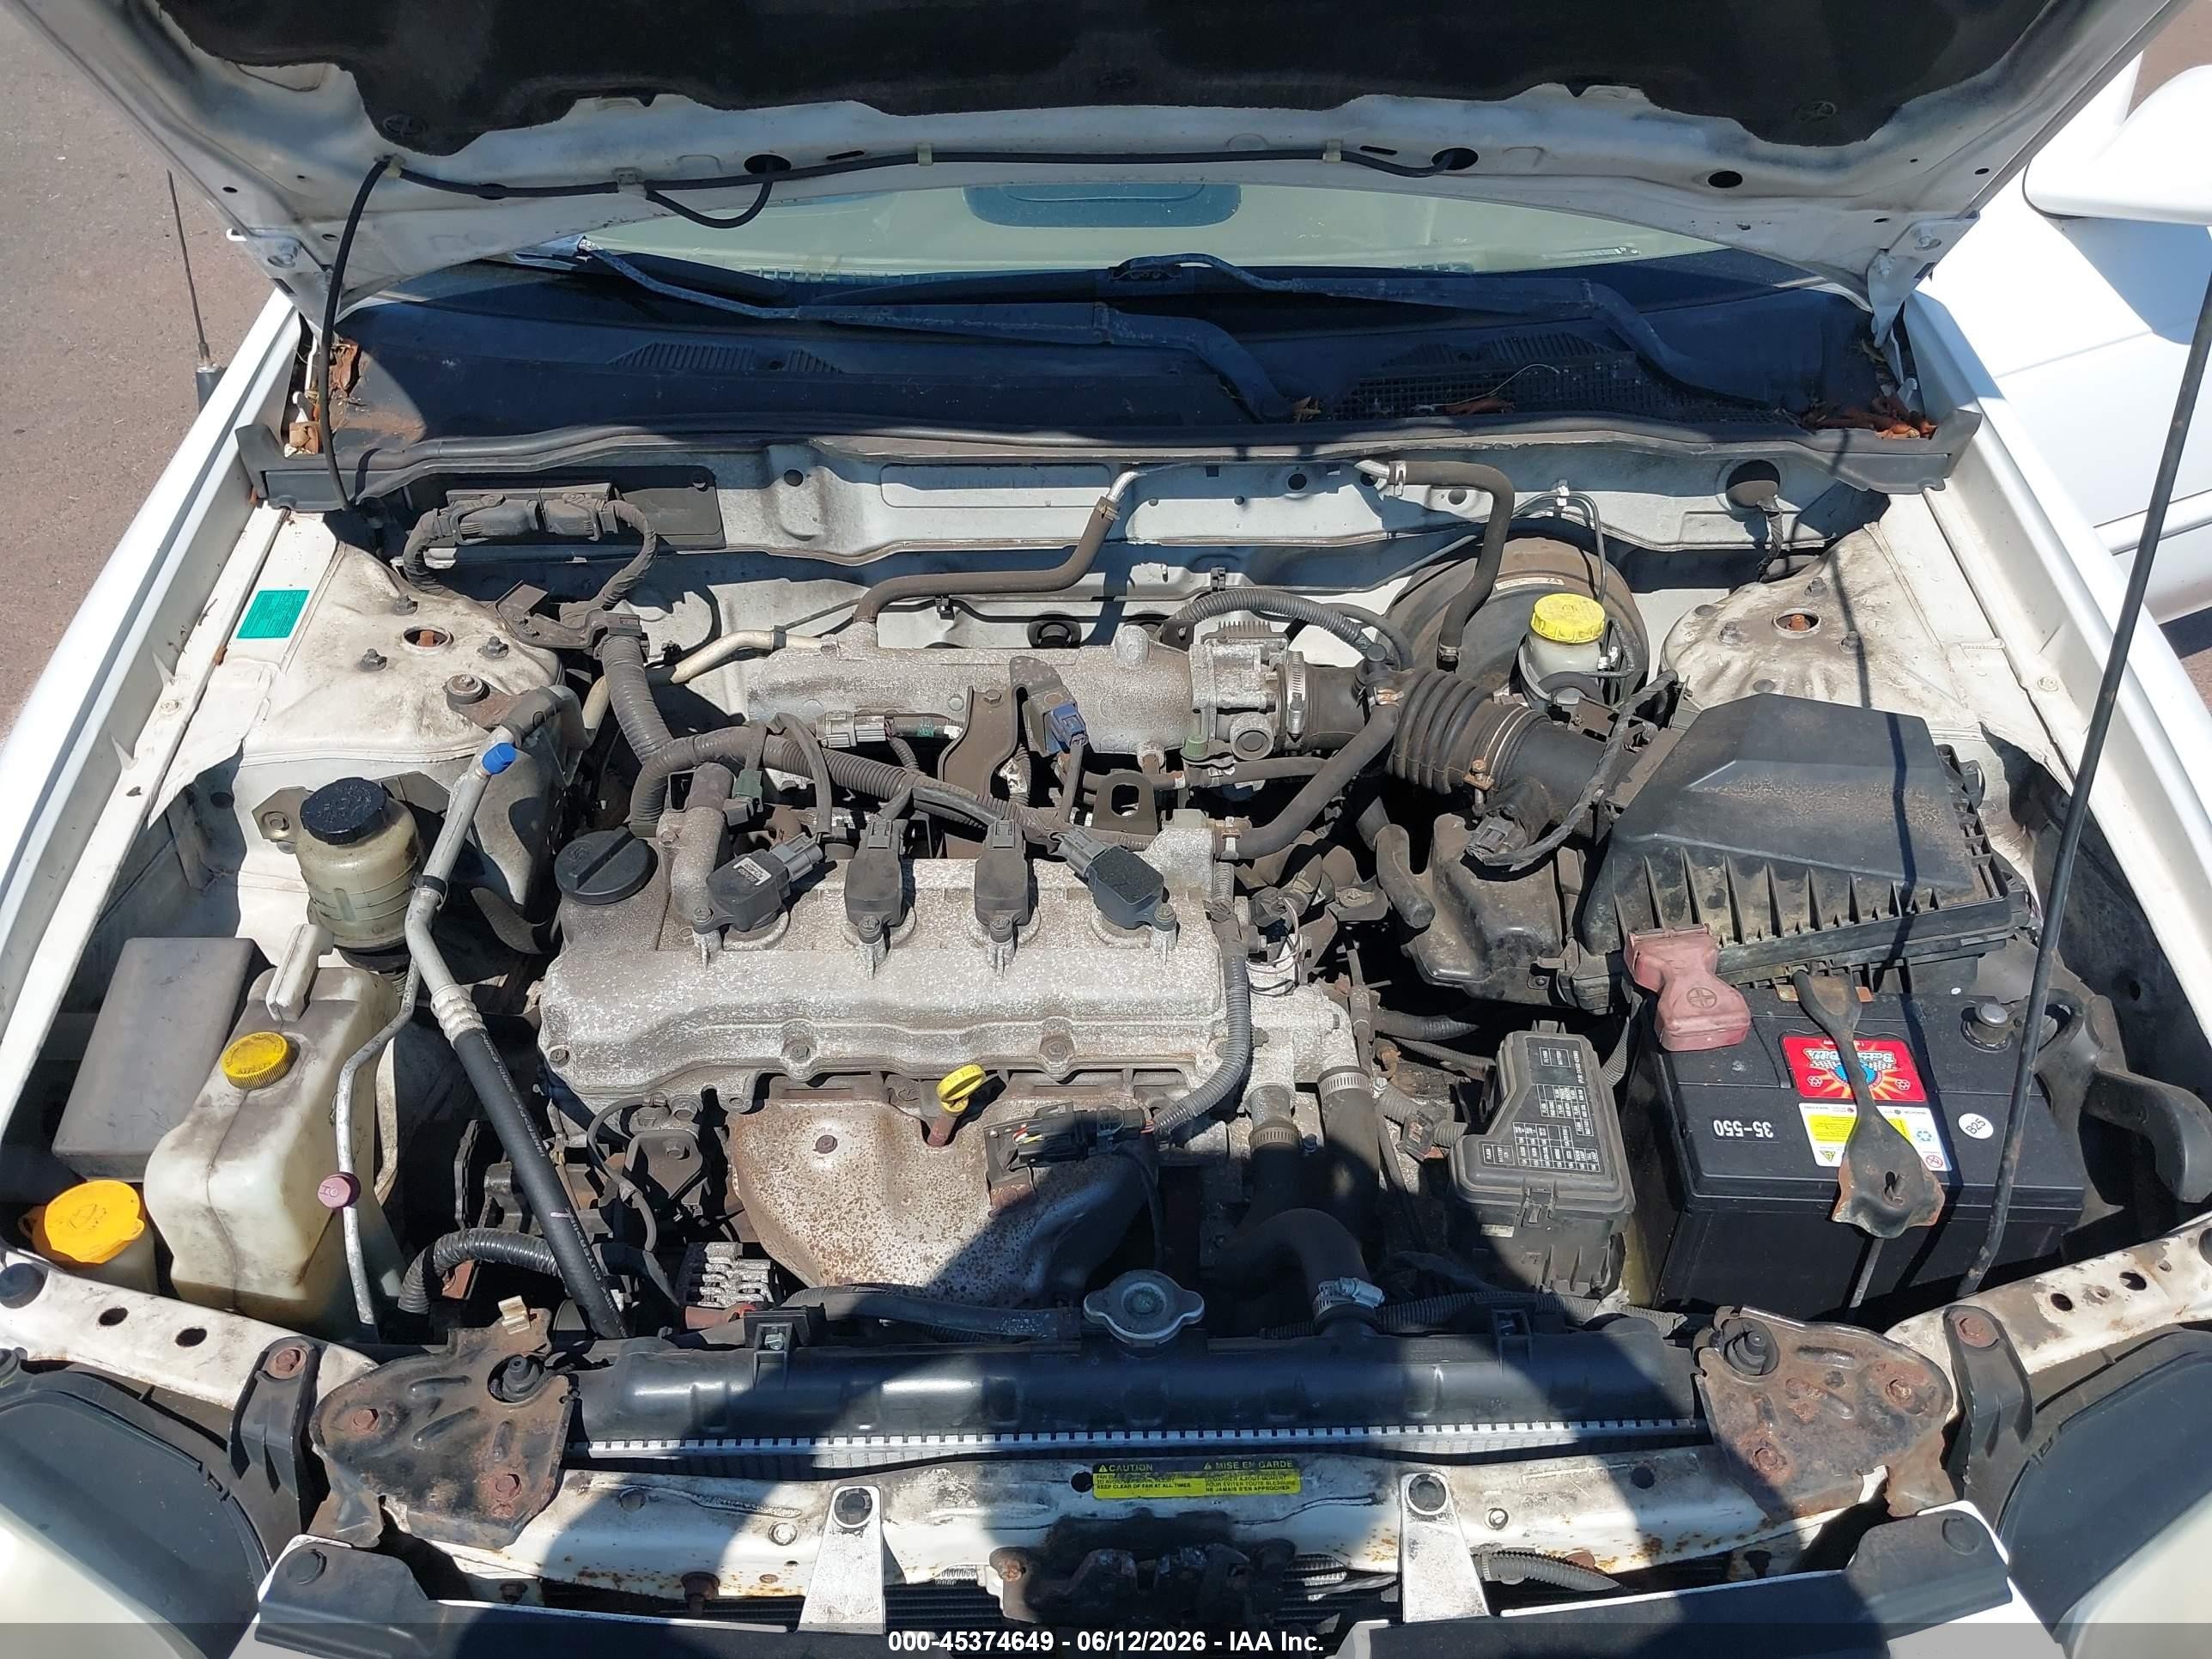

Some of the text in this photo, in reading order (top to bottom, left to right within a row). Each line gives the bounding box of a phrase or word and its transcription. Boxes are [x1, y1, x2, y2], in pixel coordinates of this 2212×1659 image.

[1713, 1120, 1774, 1139] 35-550
[1966, 1118, 1985, 1134] B25
[1109, 1463, 1153, 1472] CAUTION
[1215, 1462, 1239, 1470] MISE
[1259, 1461, 1292, 1469] GARDE
